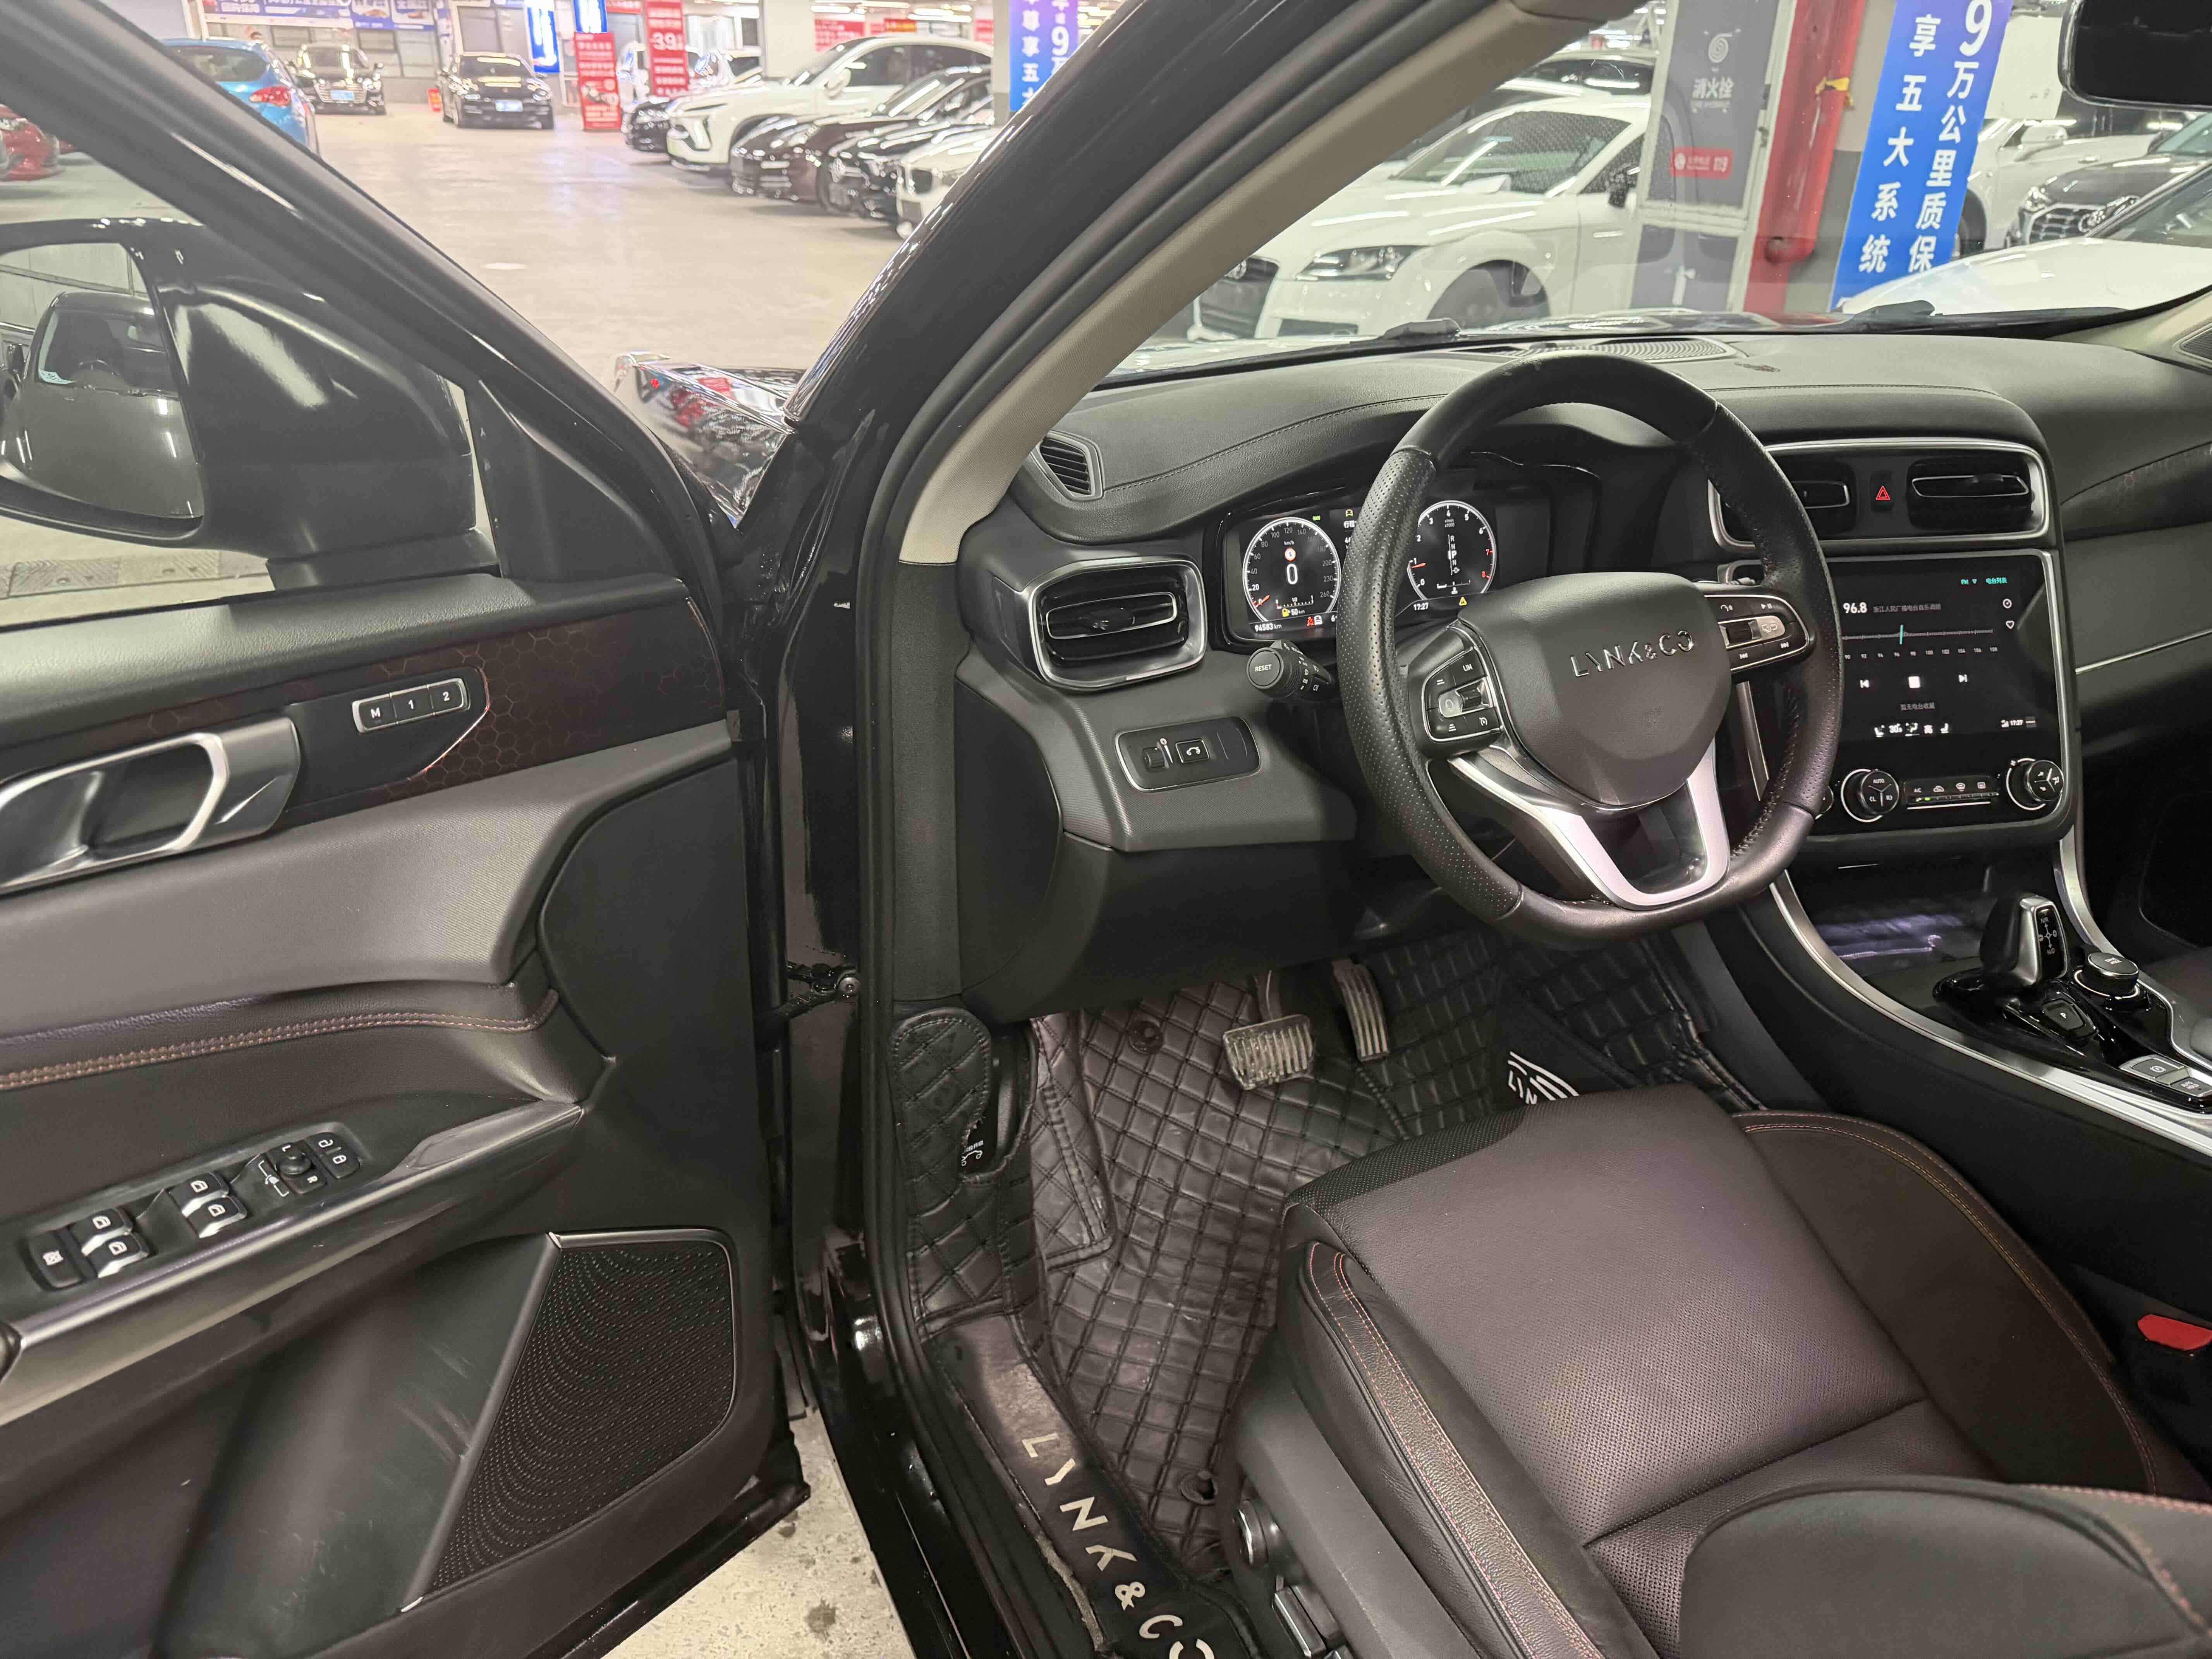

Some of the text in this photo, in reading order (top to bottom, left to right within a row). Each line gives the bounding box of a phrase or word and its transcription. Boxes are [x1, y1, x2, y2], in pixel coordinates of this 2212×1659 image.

[1908, 0, 1992, 273] 9万公里质保
[1858, 14, 1941, 273] 享五大系统
[1452, 550, 1457, 558] P
[1286, 563, 1298, 585] 0
[1413, 602, 1429, 611] 17:27
[1843, 602, 1867, 614] 96.8
[1254, 623, 1274, 632] 94583
[1255, 664, 1272, 672] RESET
[443, 692, 450, 701] 2
[408, 700, 414, 709] 1
[371, 708, 381, 718] M
[307, 1175, 318, 1183] R
